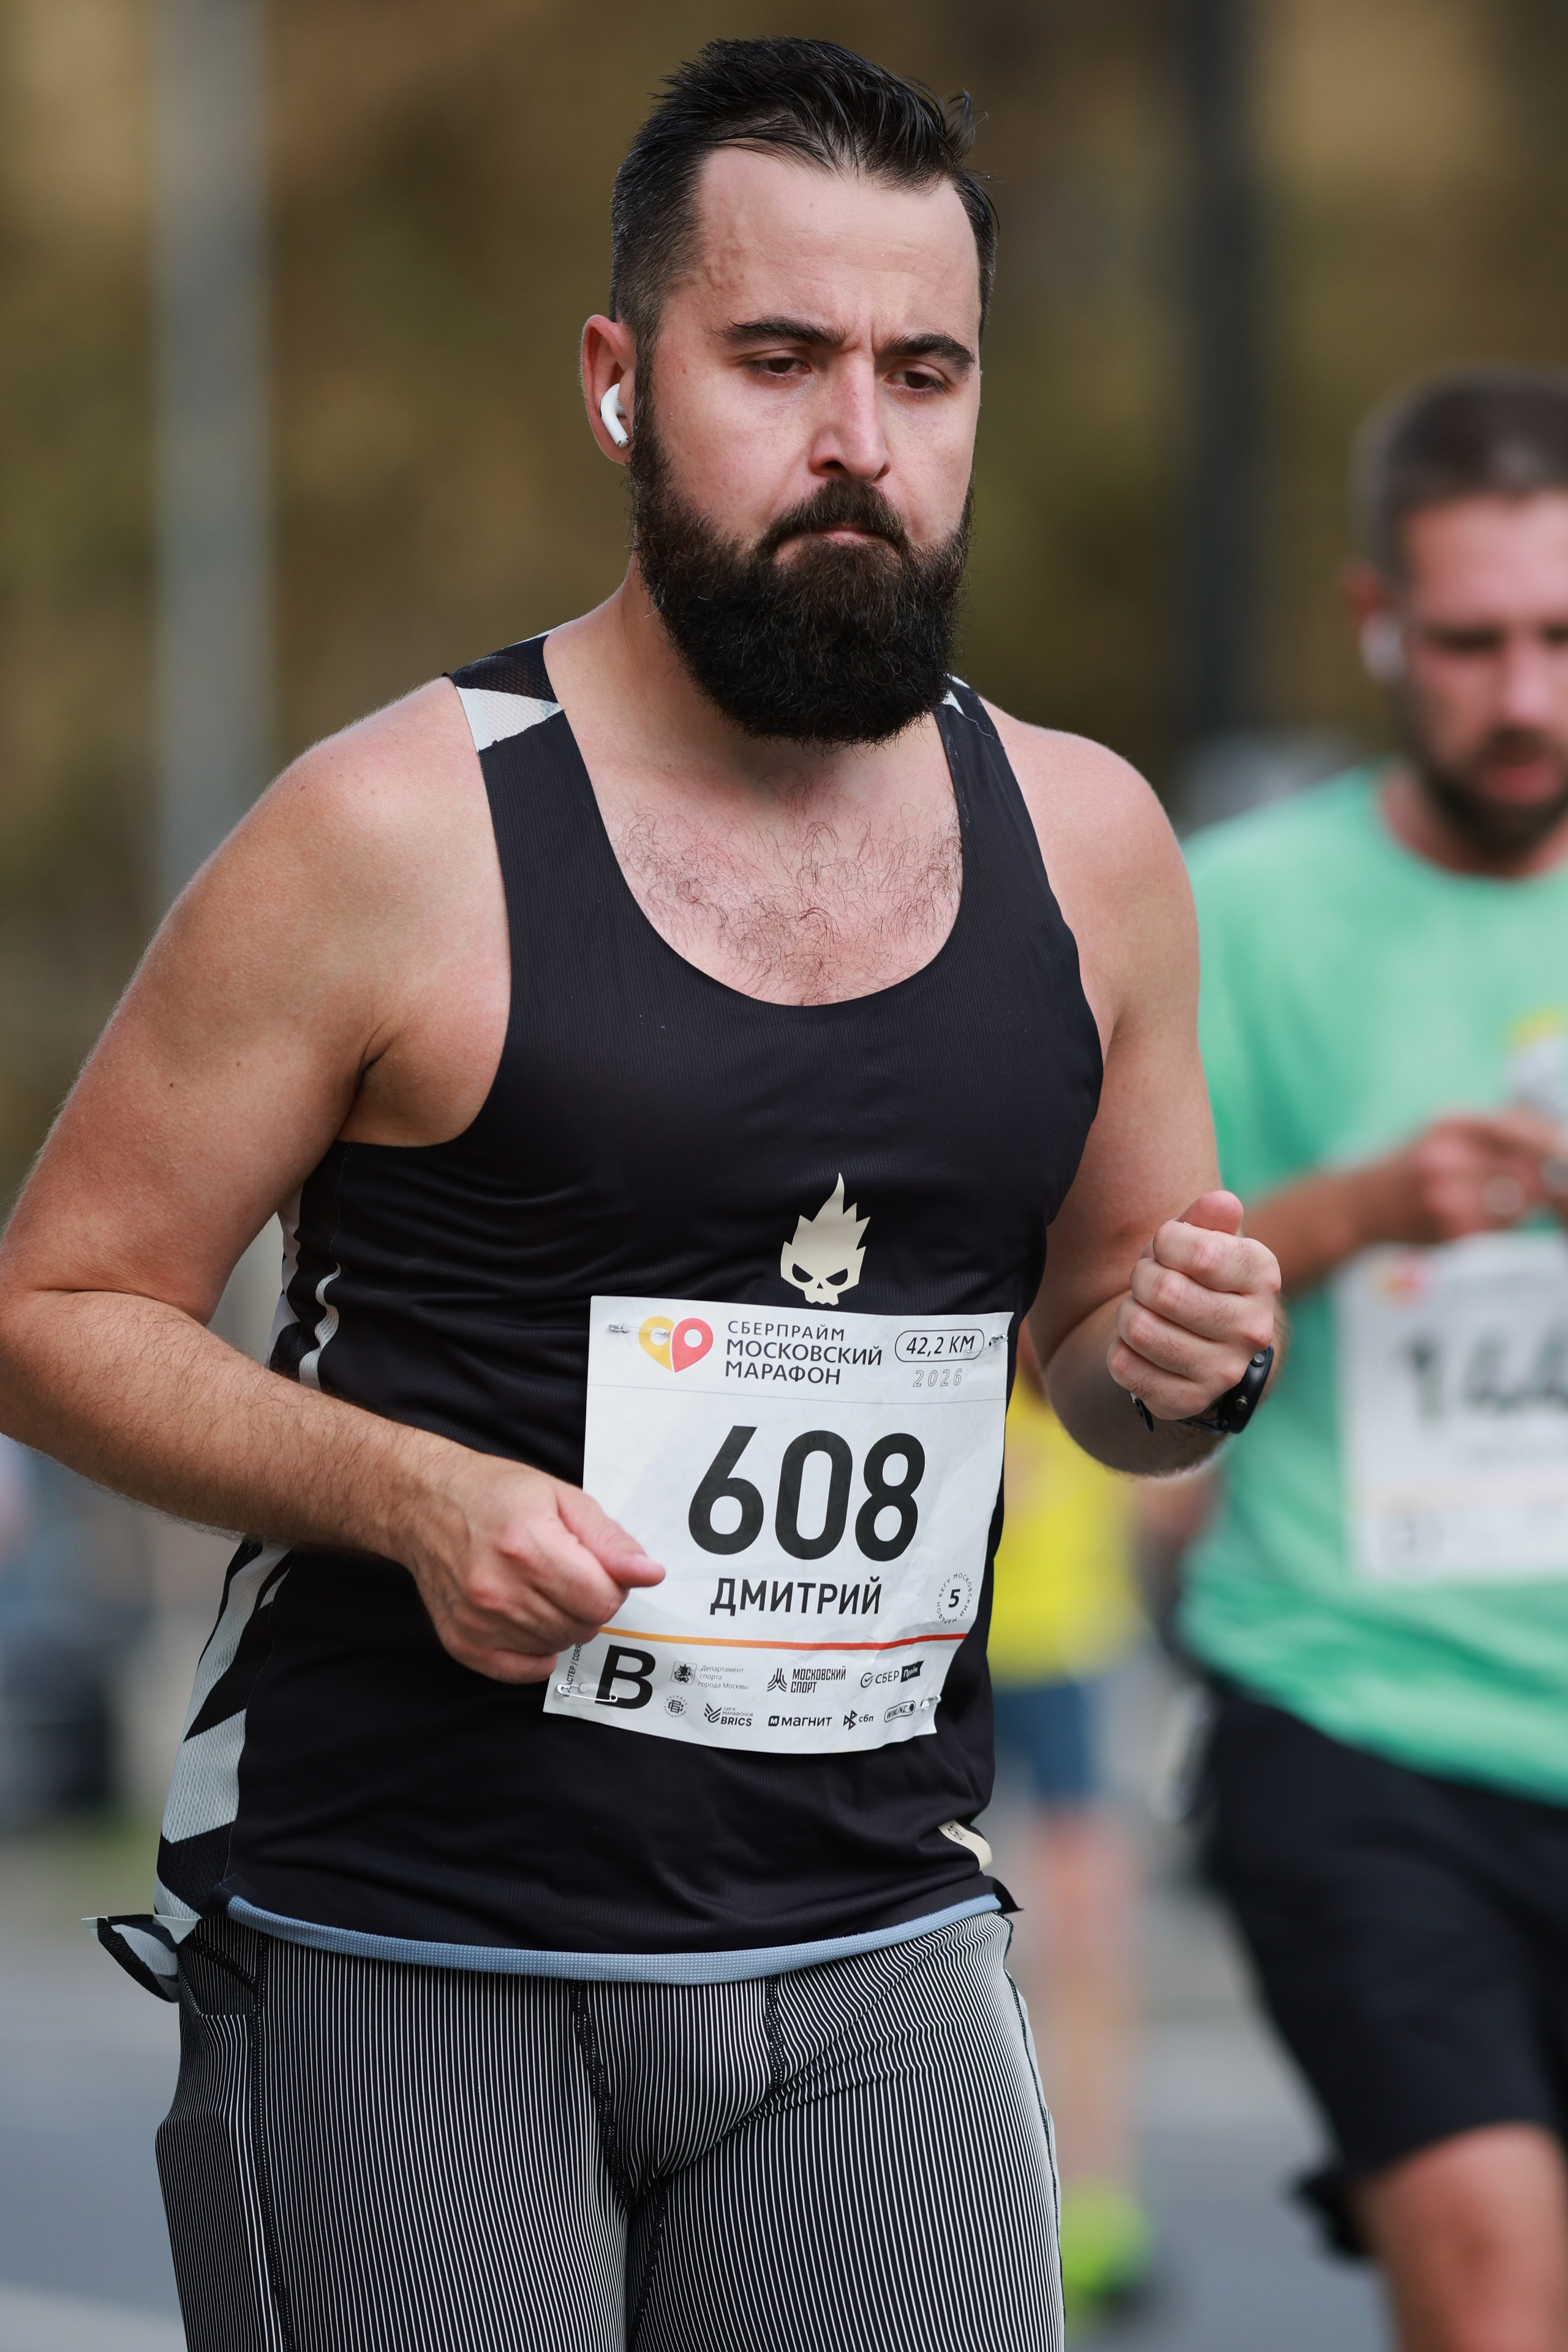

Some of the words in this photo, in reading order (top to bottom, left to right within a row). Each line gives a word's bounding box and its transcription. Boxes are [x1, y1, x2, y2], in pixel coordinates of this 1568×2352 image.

[728, 1321, 845, 1341] СБЕРПРАЙМ
[726, 1338, 883, 1366] МОСКОВСКИЙ
[906, 1336, 944, 1357] 42,2
[725, 1360, 840, 1385] МАРАФОН
[912, 1368, 963, 1387] 2026
[688, 1425, 925, 1562] 608
[709, 1575, 883, 1616] ДМИТРИЙ
[948, 1588, 961, 1608] 5
[699, 1673, 723, 1681] спорта
[700, 1665, 745, 1674] Департамент
[792, 1665, 846, 1681] МОСКОВСКИЙ
[875, 1670, 900, 1684] СБЕР
[698, 1681, 722, 1690] города
[790, 1681, 818, 1694] СПОРТ
[720, 1716, 753, 1727] BRICS
[781, 1716, 832, 1727] магнит
